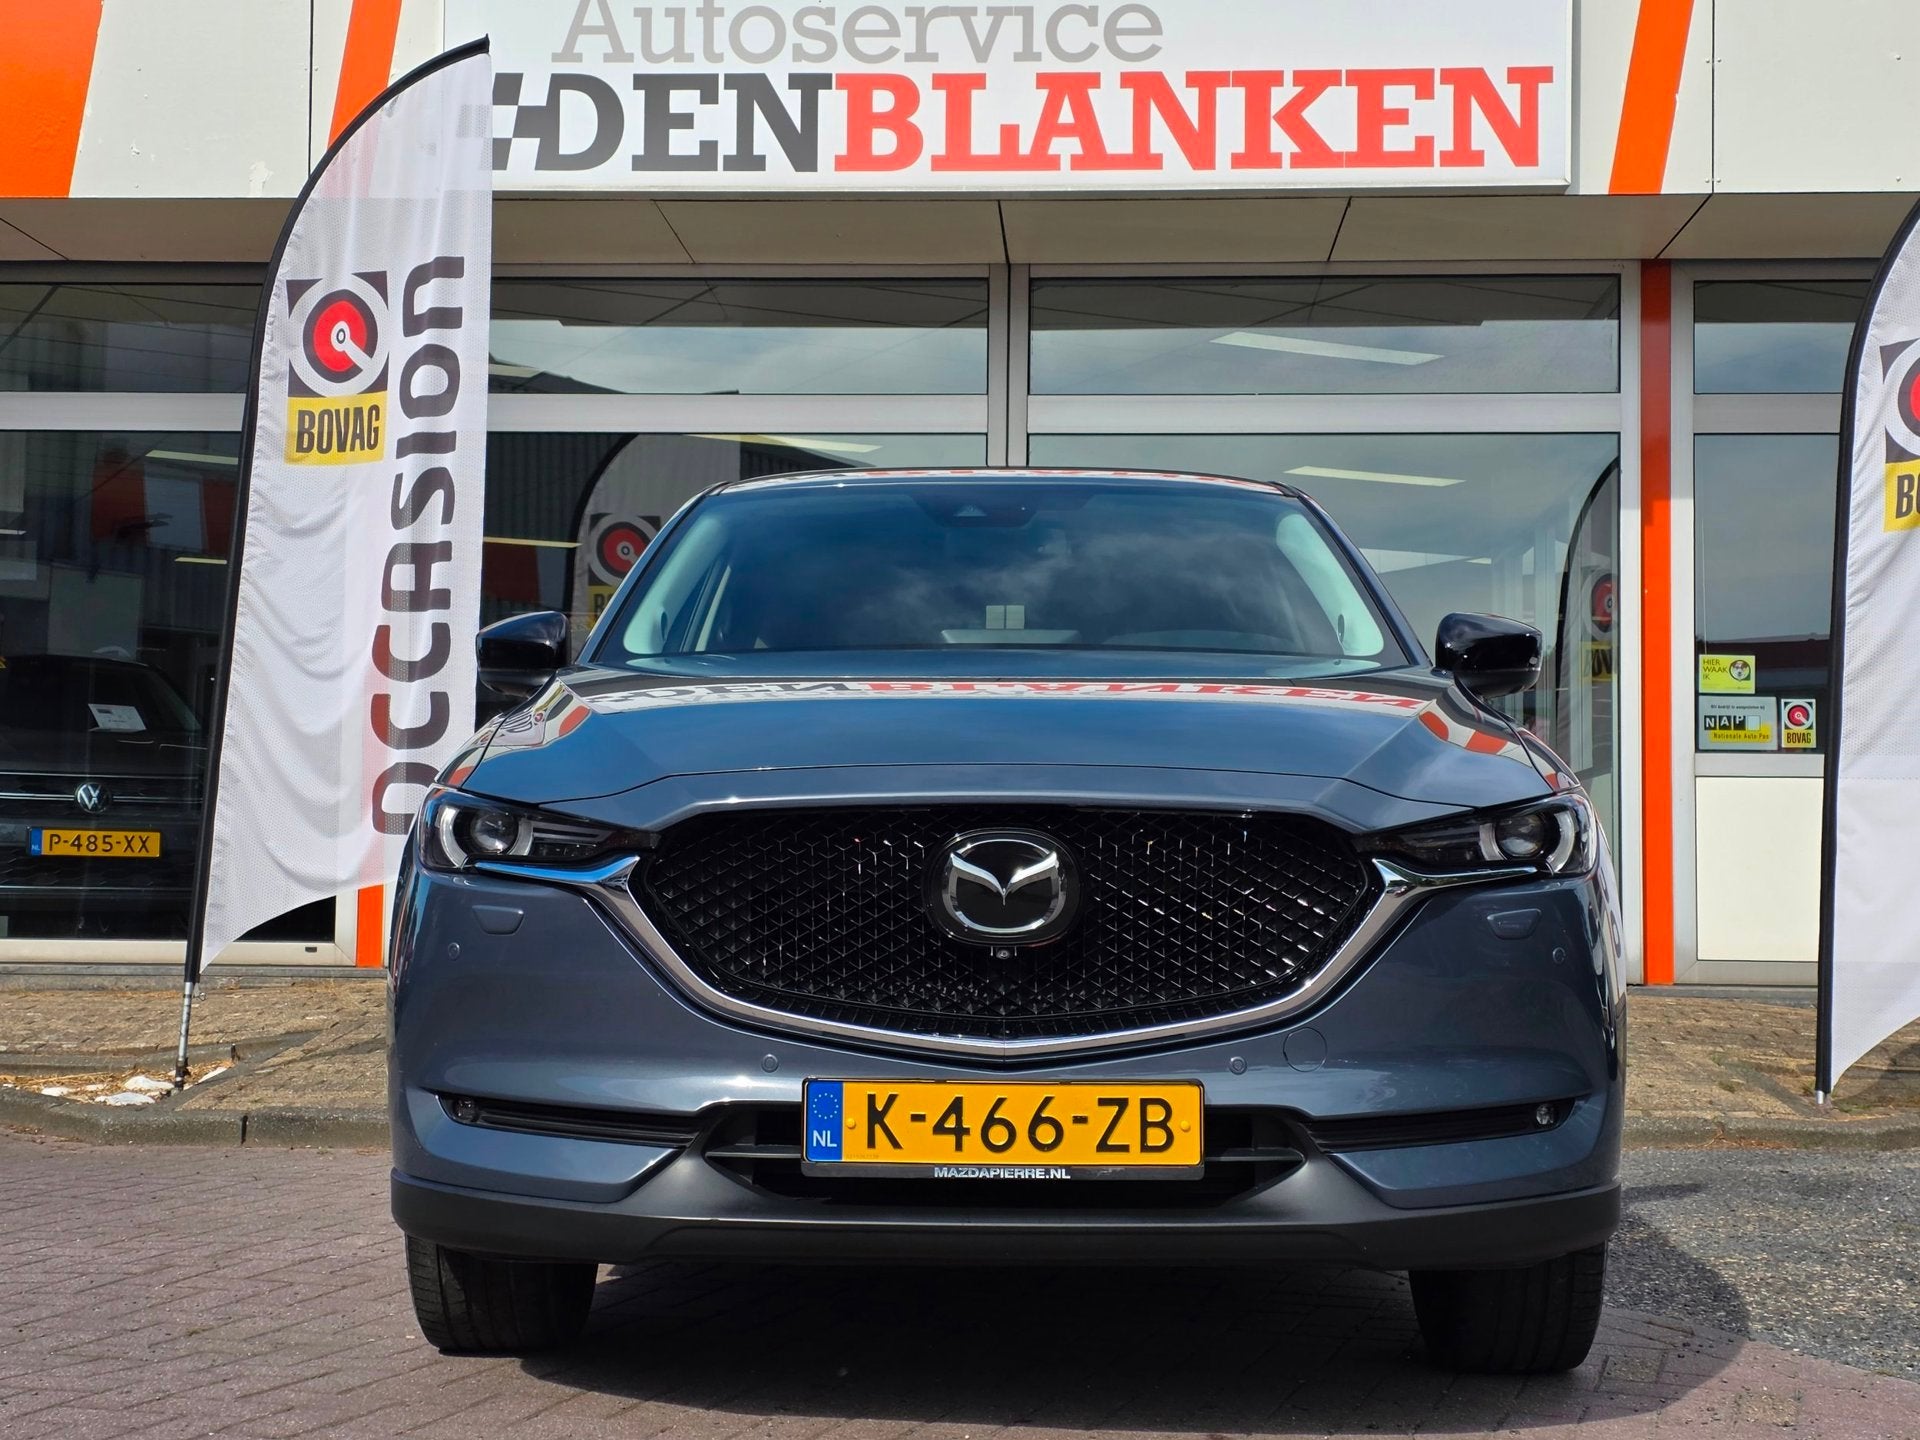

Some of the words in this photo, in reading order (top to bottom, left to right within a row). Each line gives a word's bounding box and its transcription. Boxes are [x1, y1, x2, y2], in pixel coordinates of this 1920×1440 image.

[552, 0, 1164, 64] Autoservice
[296, 405, 380, 454] BOVAG
[1705, 715, 1745, 728] NAP
[1786, 733, 1811, 744] BOVAG
[49, 833, 150, 853] P-485-XX
[865, 1092, 1175, 1154] K-466-ZB
[812, 1130, 837, 1148] NL
[934, 1166, 1071, 1180] MAZDAPIERRE.NL
